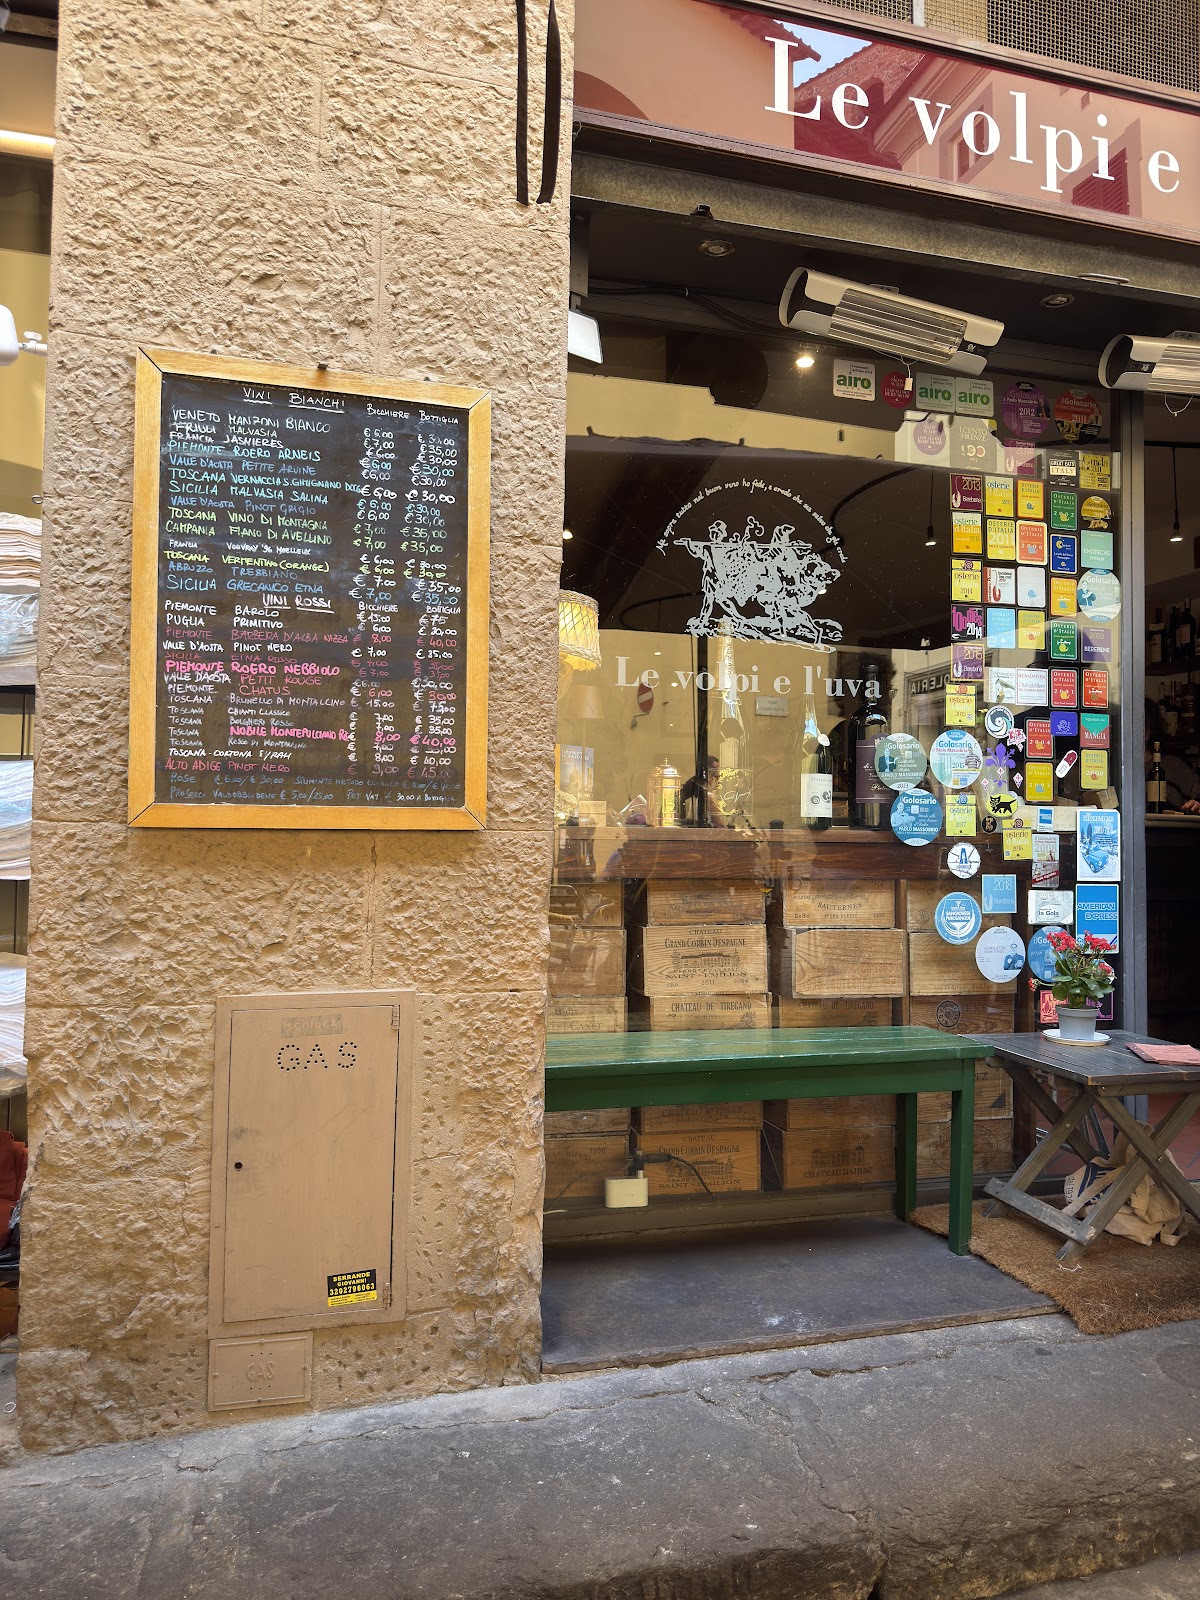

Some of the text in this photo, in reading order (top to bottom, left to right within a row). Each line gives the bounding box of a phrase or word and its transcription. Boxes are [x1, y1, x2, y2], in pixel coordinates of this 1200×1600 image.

[764, 36, 1180, 194] Le volpi e
[837, 372, 872, 390] airo
[243, 388, 345, 409] VINI BIANCHI
[918, 384, 952, 401] airo
[958, 390, 991, 406] airo
[172, 409, 331, 433] VENETO MANZONI BIANCO
[229, 425, 277, 438] MALVASIA
[168, 440, 321, 462] PIEMONTE ROERO ARNEIS
[168, 467, 226, 483] TOSCANA
[1051, 467, 1075, 475] ITALY
[962, 480, 981, 490] 2013
[987, 481, 1010, 490] osterie
[169, 480, 329, 505] SICILIA MALVASIA SALINA
[245, 500, 276, 512] PINOT
[168, 507, 217, 522] TOSCANA
[227, 511, 254, 523] VINO
[277, 515, 328, 531] MONTAGNA
[953, 517, 978, 526] osterie
[166, 521, 216, 536] CAMPANIA
[229, 525, 262, 538] FIANO
[282, 531, 332, 545] AVELLINO
[163, 550, 210, 563] TOSCANA
[231, 566, 298, 580] TREBBIANO
[954, 572, 979, 581] osterie
[166, 574, 217, 590] SICILIA
[263, 594, 331, 608] VINI ROSSI
[165, 600, 280, 617] PIEMONTE BAROLO
[166, 614, 283, 628] PUGLIA PRIMITIVO
[166, 627, 214, 640] PIEMONTE
[231, 630, 280, 641] BARBERA
[163, 641, 185, 650] VALLE
[233, 642, 262, 652] PINOT
[267, 643, 293, 652] NERO
[964, 648, 982, 660] 2015
[166, 660, 340, 676] PIEMONTE ROERO NEBBIOLO
[240, 675, 276, 685] PETIT
[615, 656, 660, 688] Le
[675, 662, 761, 704] volpi
[774, 675, 791, 694] e
[804, 665, 882, 699] l'uva
[239, 686, 291, 697] CHATUS
[229, 726, 267, 737] NOBILE
[165, 757, 188, 770] ALTO
[994, 880, 1013, 890] 2018
[817, 902, 862, 911] SAUTERNES
[1077, 902, 1115, 911] AMERICAN
[1085, 911, 1117, 920] EXPRESS
[277, 1041, 358, 1072] GAS
[333, 1271, 370, 1282] SERRANDE
[337, 1278, 367, 1286] GIOVANNI
[330, 1283, 374, 1296] 3202796063
